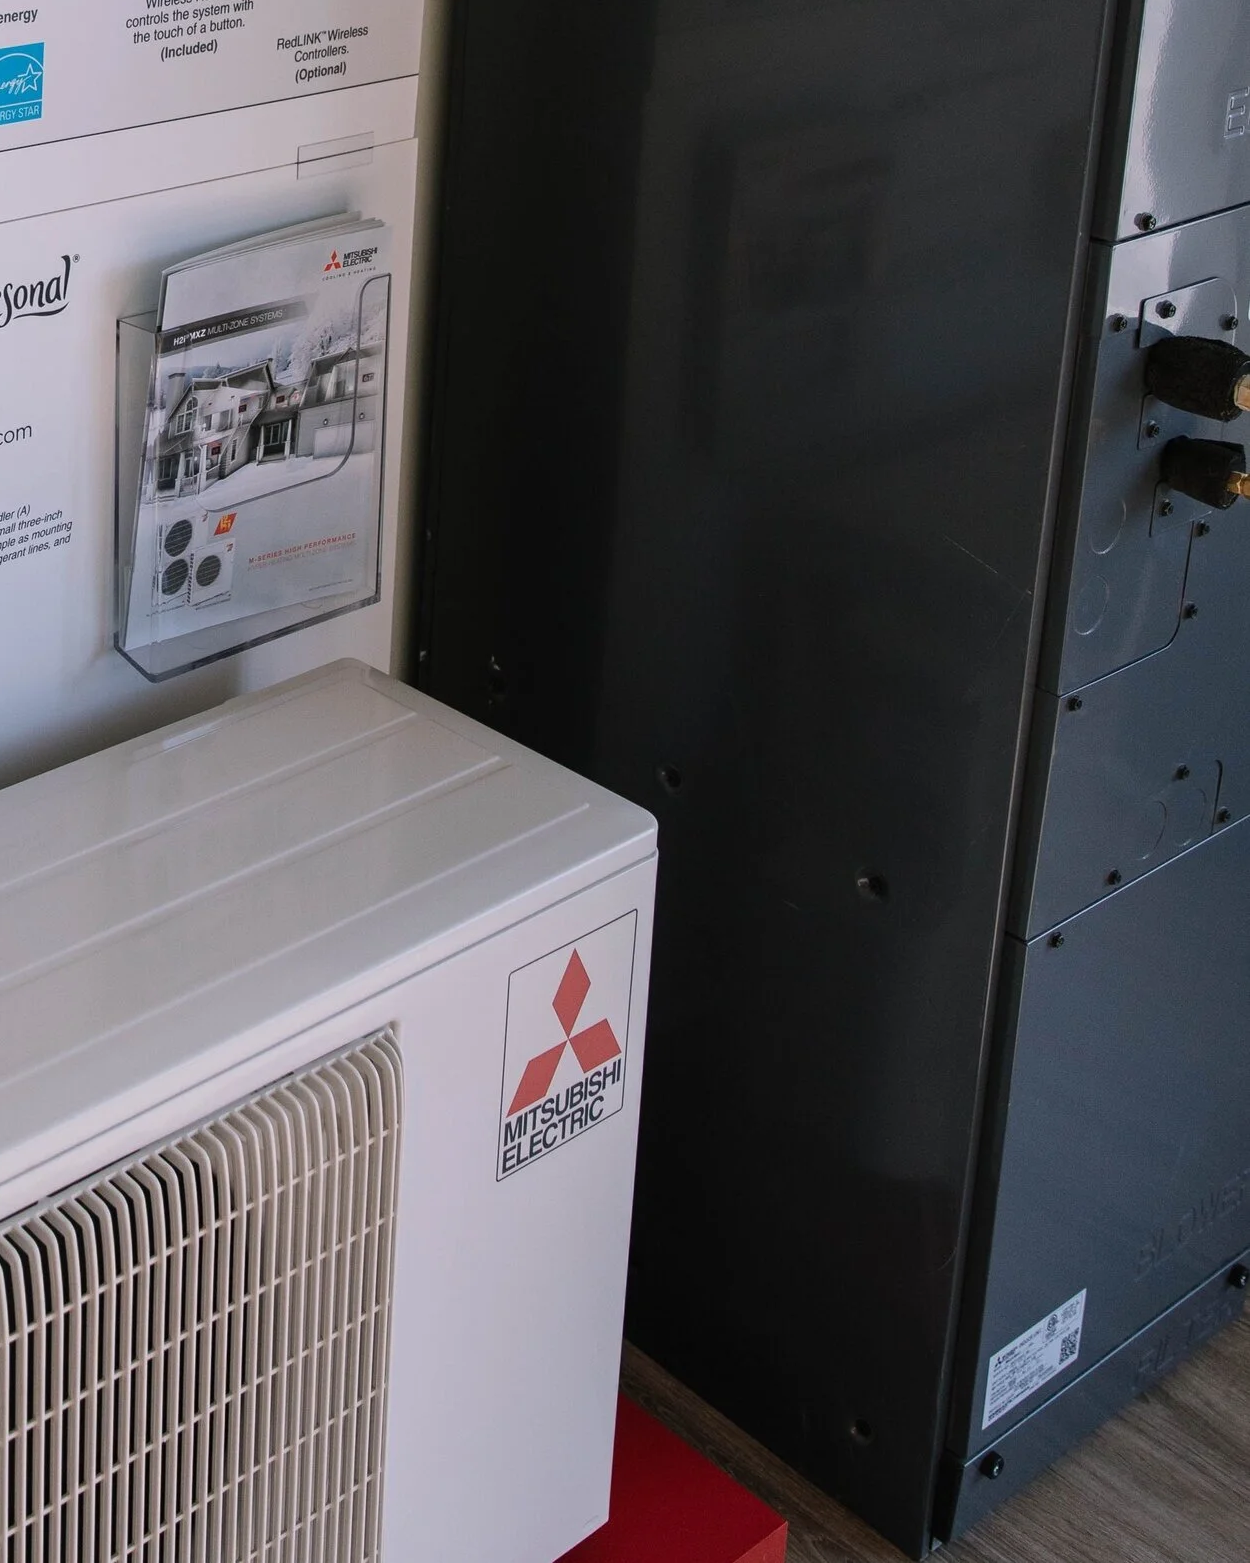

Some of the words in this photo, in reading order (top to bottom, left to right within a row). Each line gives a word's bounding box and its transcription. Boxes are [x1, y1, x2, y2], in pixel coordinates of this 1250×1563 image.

[125, 11, 170, 29] controls
[172, 9, 190, 22] the
[192, 4, 230, 21] system
[133, 30, 151, 45] the
[153, 25, 184, 41] touch
[186, 21, 198, 36] of
[199, 23, 207, 34] a
[209, 17, 246, 32] button.
[327, 26, 369, 42] Wireless
[160, 38, 218, 63] (Included)
[294, 45, 349, 63] Controllers.
[295, 61, 347, 84] (Optional)
[18, 105, 40, 118] STAR
[342, 256, 373, 268] ELECTRIC
[16, 504, 31, 520] (A)
[284, 544, 303, 555] HIGH
[304, 532, 357, 550] PERFORMANCE
[504, 1059, 621, 1147] MITSUBISHI
[502, 1095, 604, 1175] ELECTRIC
